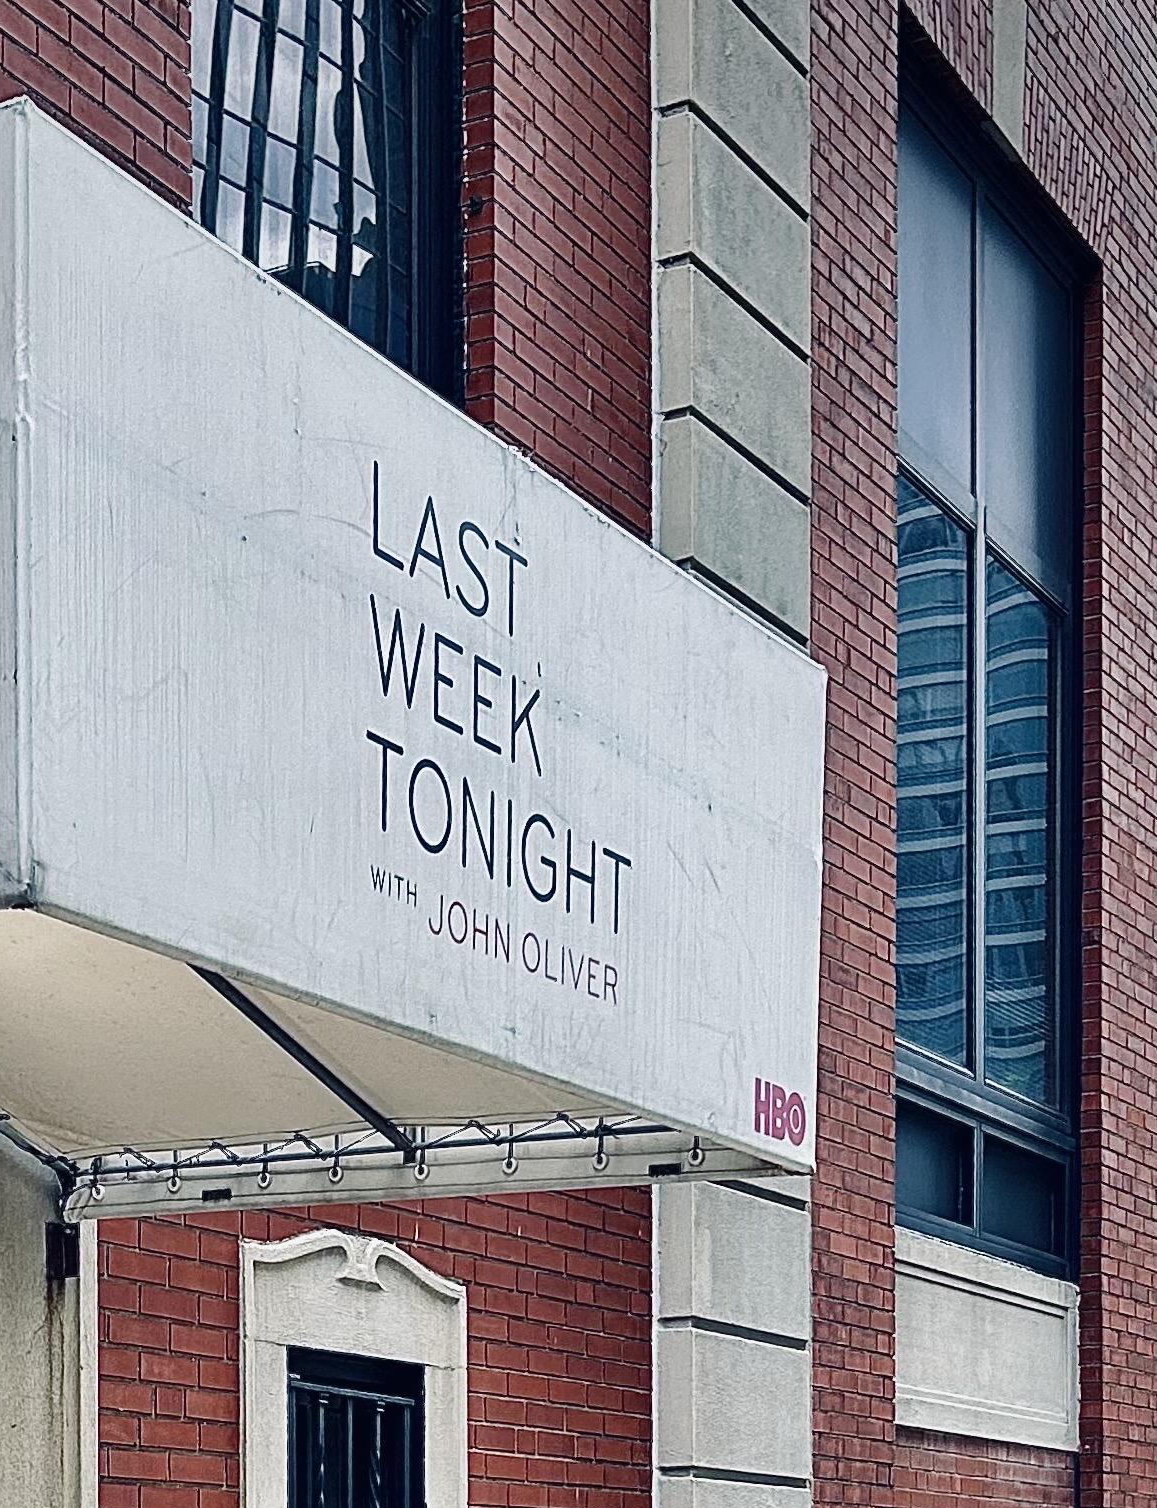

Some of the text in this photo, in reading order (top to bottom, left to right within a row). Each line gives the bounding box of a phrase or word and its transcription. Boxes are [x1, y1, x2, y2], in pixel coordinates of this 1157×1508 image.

[372, 459, 529, 638] LAST
[369, 593, 542, 778] WEEK
[365, 729, 633, 935] TONIGHT
[370, 864, 619, 1006] WITH JOHN OLIVER
[754, 1076, 806, 1147] HBO
